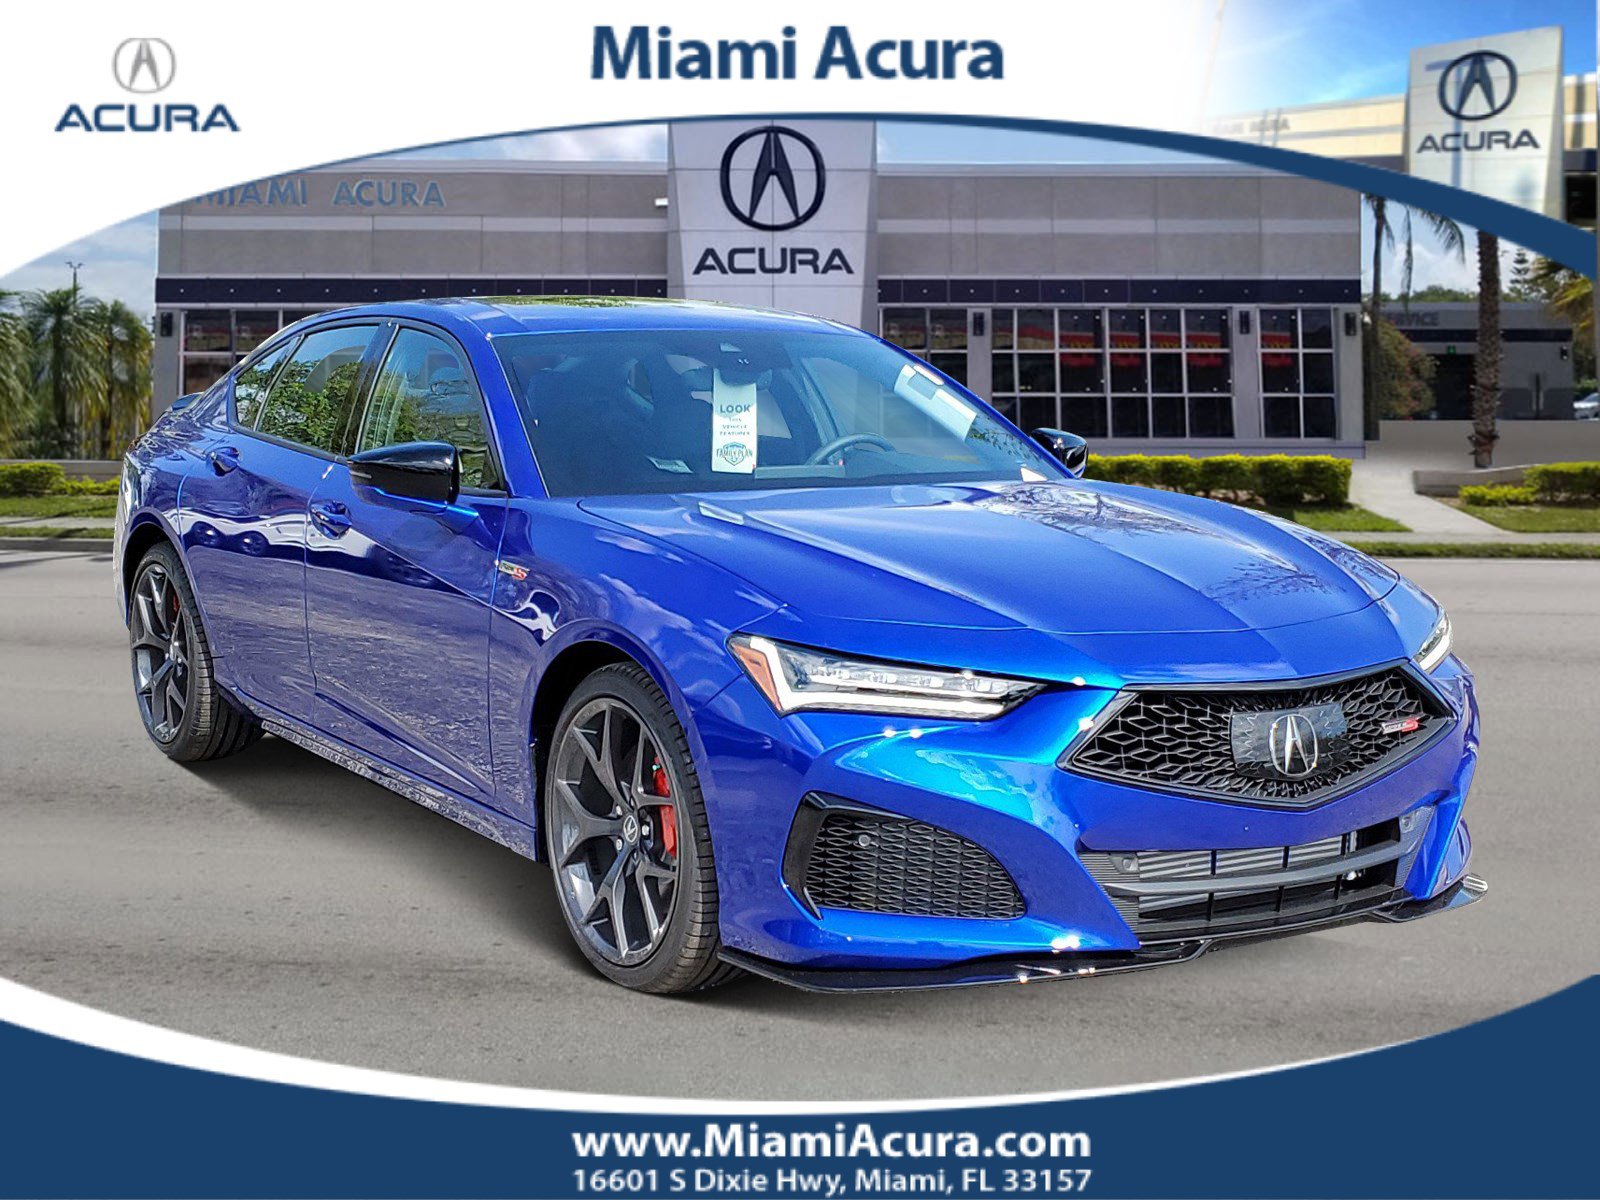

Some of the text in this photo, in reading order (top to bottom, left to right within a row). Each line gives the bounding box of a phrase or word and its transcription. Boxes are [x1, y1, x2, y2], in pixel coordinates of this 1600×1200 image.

[1416, 129, 1540, 154] ACURA
[332, 180, 446, 208] ACURA
[692, 247, 855, 276] ACURA
[720, 404, 751, 414] LOOK
